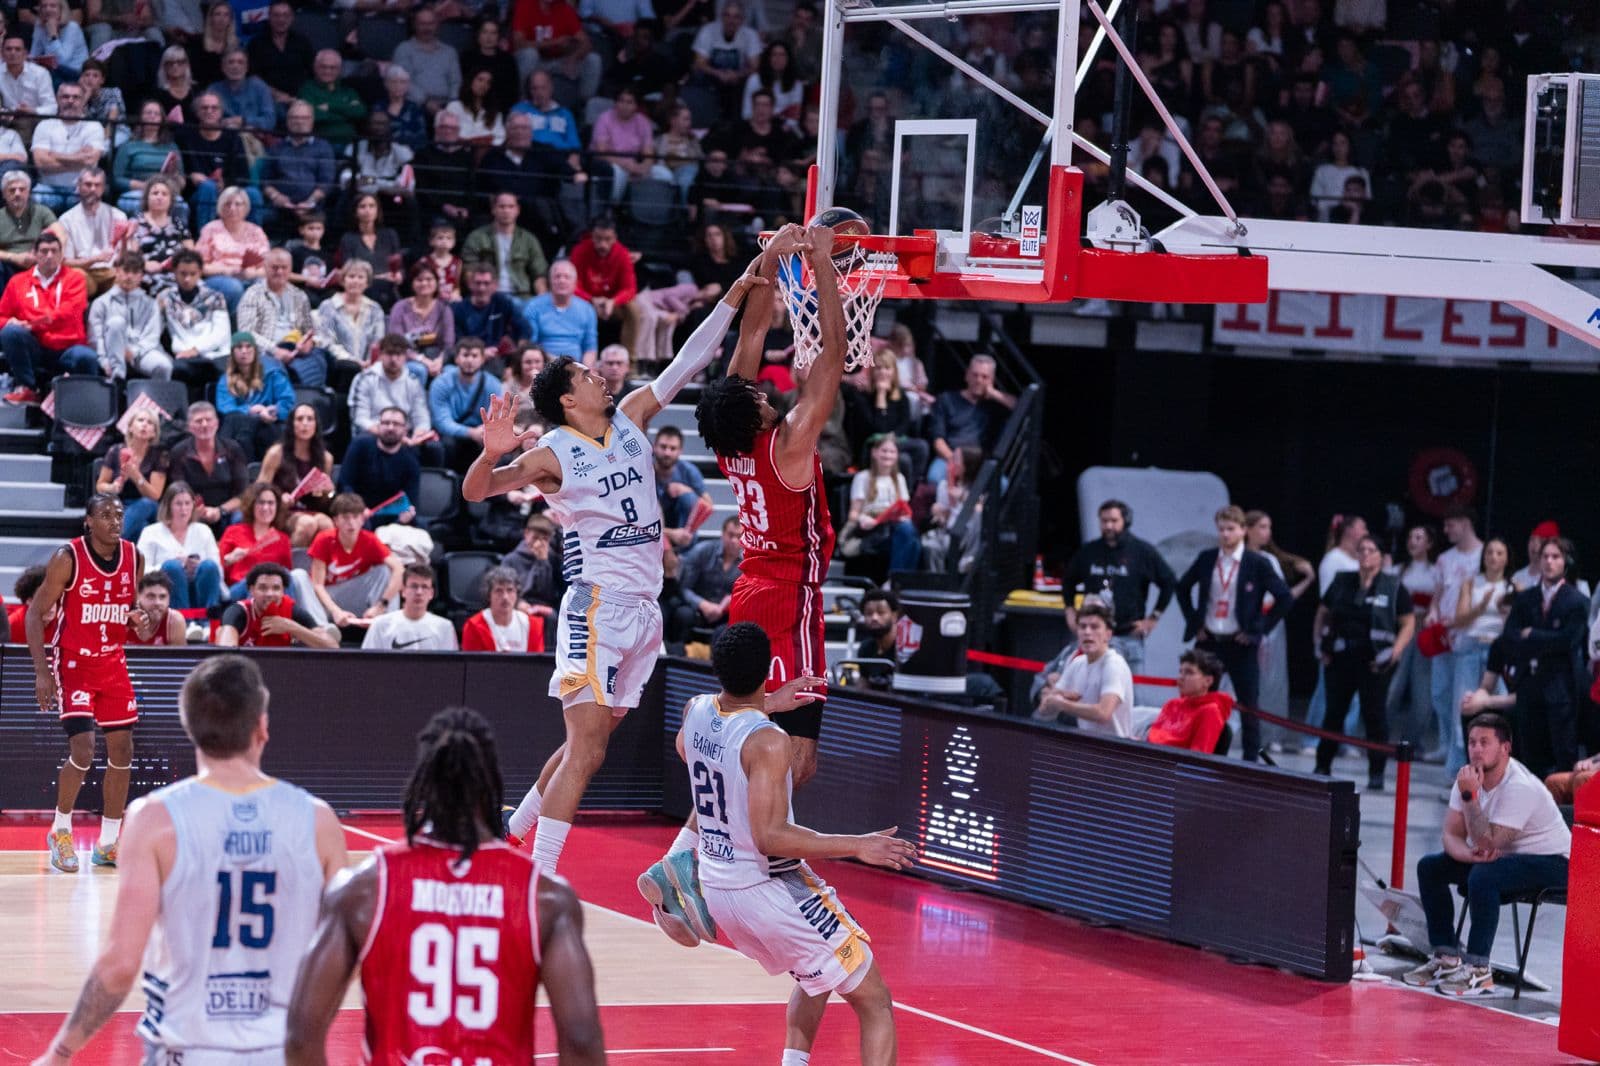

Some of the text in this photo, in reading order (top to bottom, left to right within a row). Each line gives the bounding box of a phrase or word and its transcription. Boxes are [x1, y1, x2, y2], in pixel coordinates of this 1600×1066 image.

[598, 466, 643, 498] JDA
[620, 497, 639, 523] 8
[81, 603, 130, 625] BOURG
[99, 624, 109, 643] 3
[693, 760, 729, 825] 21
[212, 870, 278, 950] 15
[407, 921, 500, 1031] 95
